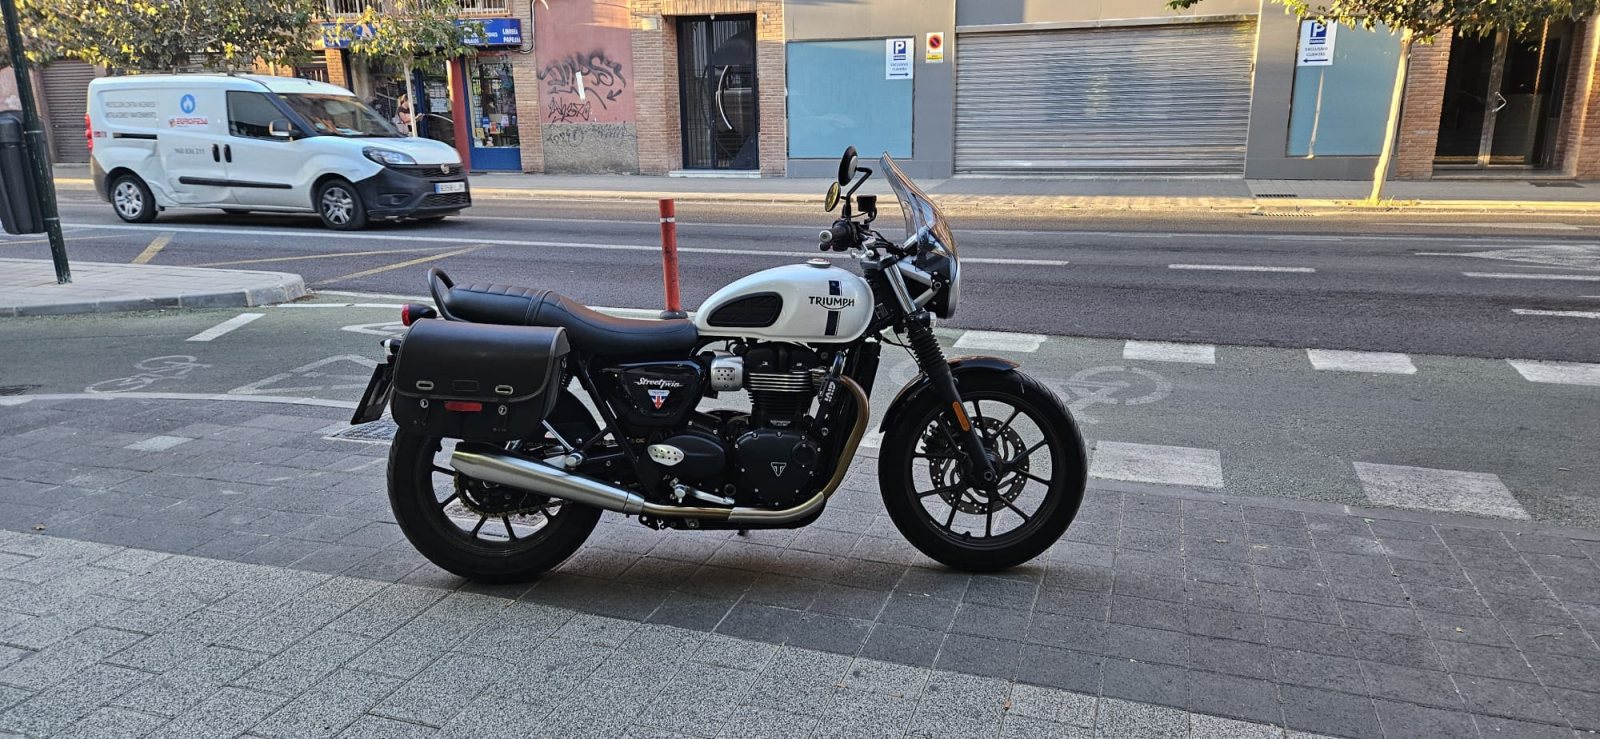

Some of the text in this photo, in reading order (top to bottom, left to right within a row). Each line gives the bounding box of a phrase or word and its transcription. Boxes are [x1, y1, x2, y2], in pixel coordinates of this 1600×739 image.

[1312, 22, 1326, 37] P
[895, 41, 905, 54] P
[808, 296, 855, 308] TRIUMPH
